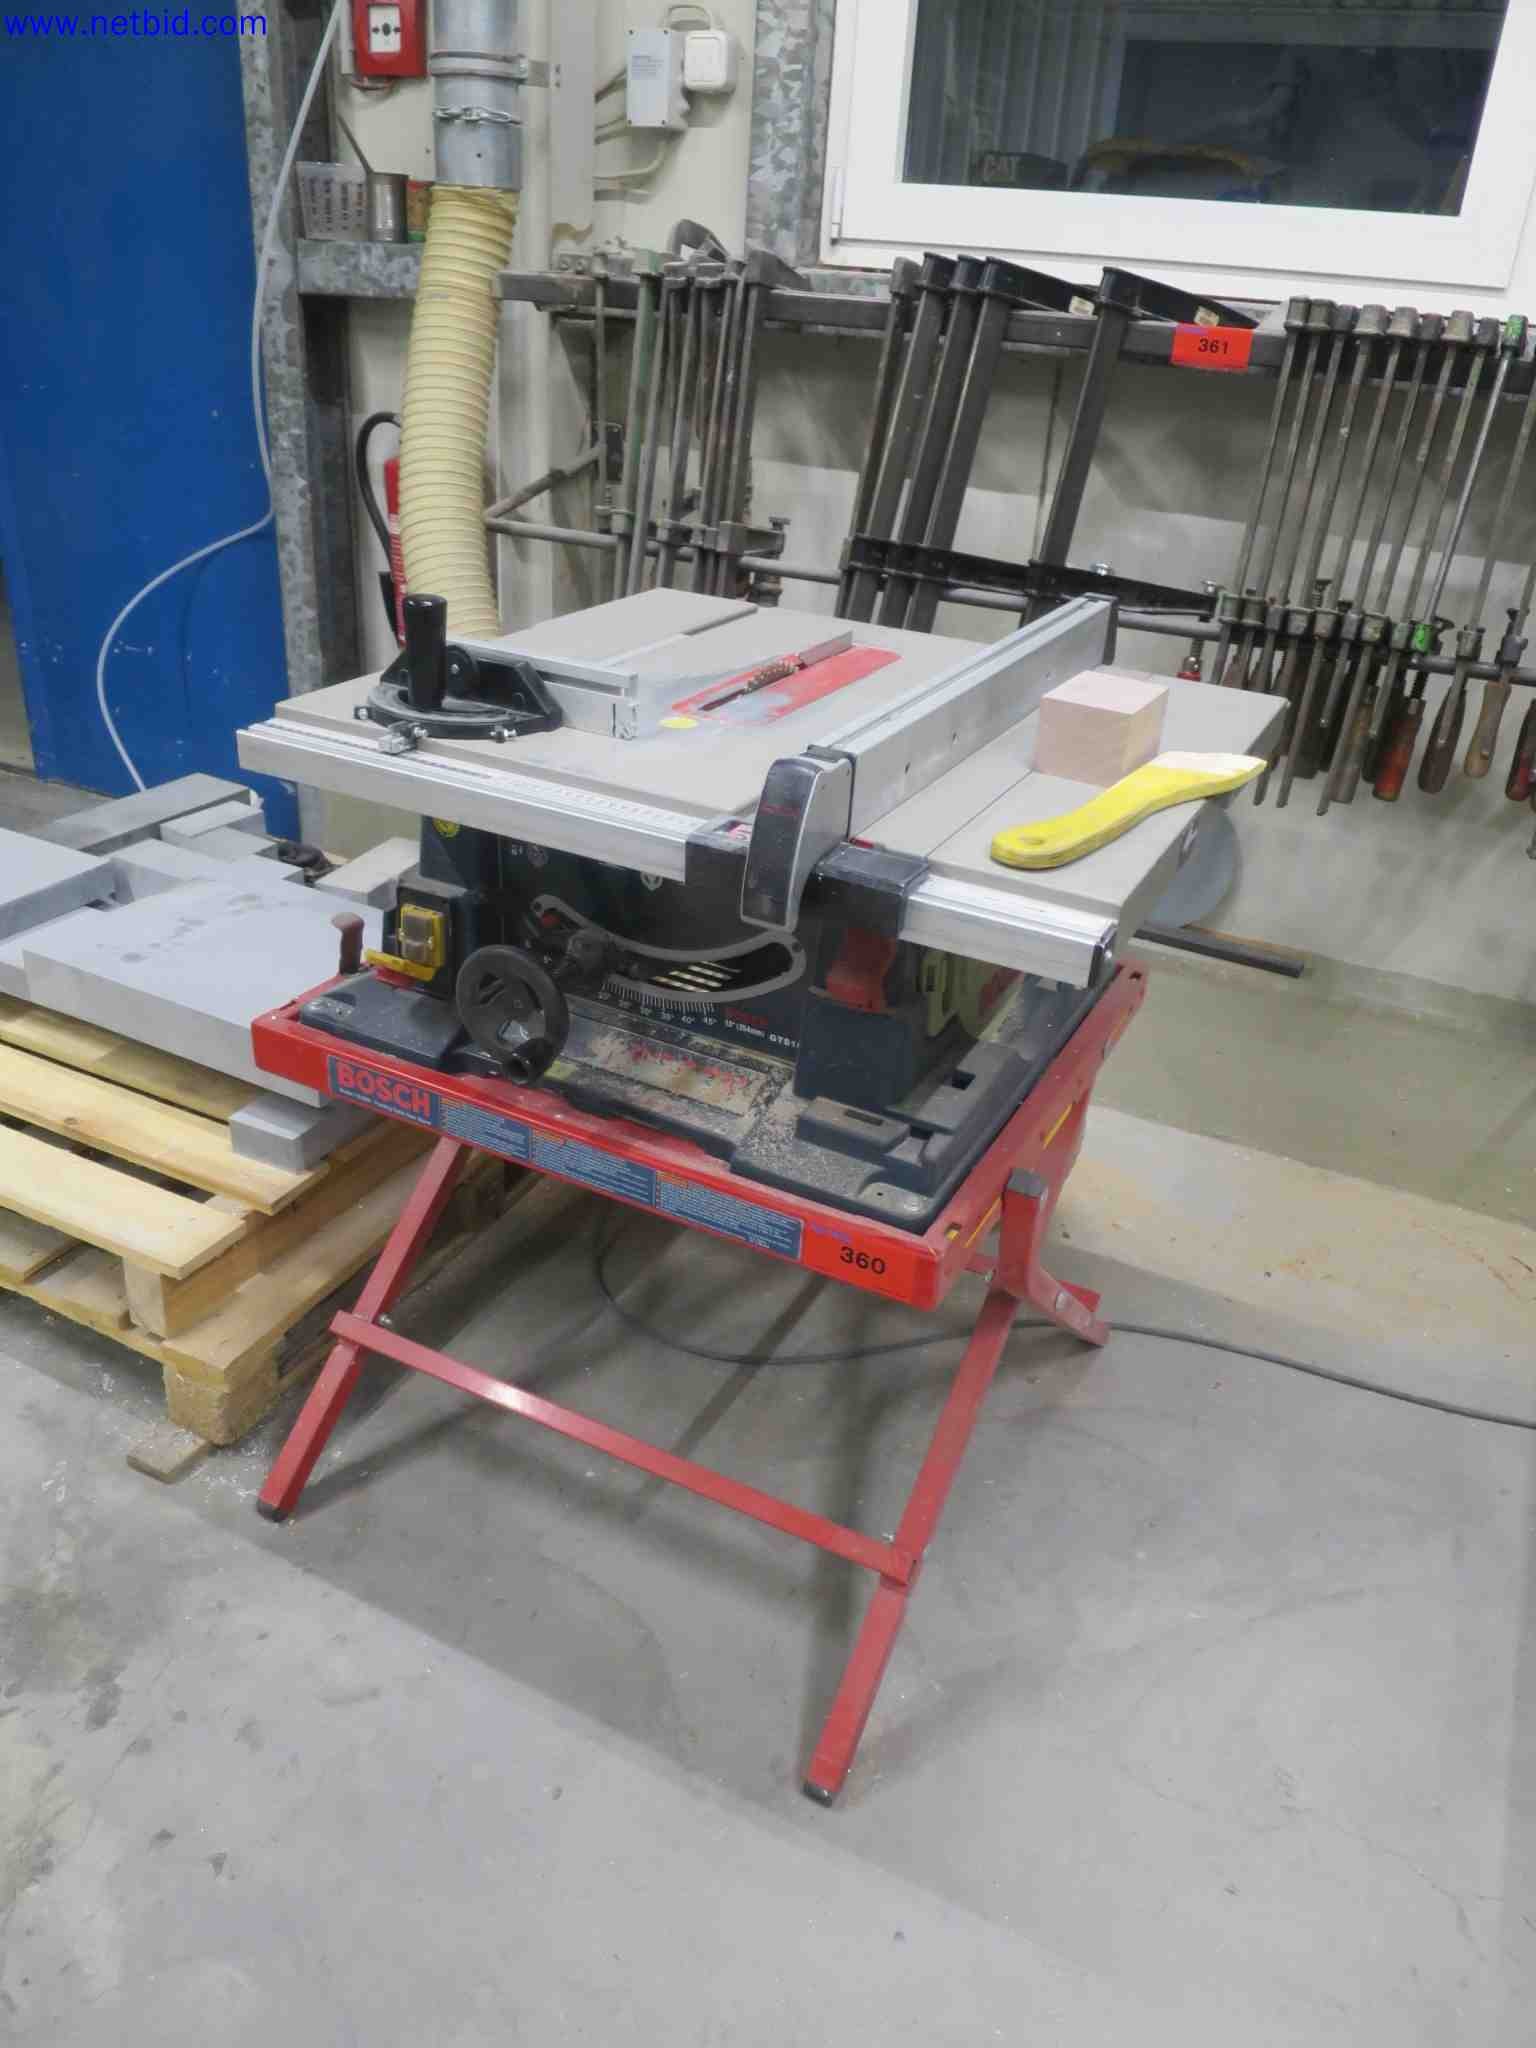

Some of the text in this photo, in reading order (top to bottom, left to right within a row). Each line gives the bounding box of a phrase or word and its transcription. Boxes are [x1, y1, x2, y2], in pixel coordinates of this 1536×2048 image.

[1198, 337, 1229, 355] 361
[336, 1062, 431, 1119] BOSCH
[840, 1245, 886, 1275] 360
